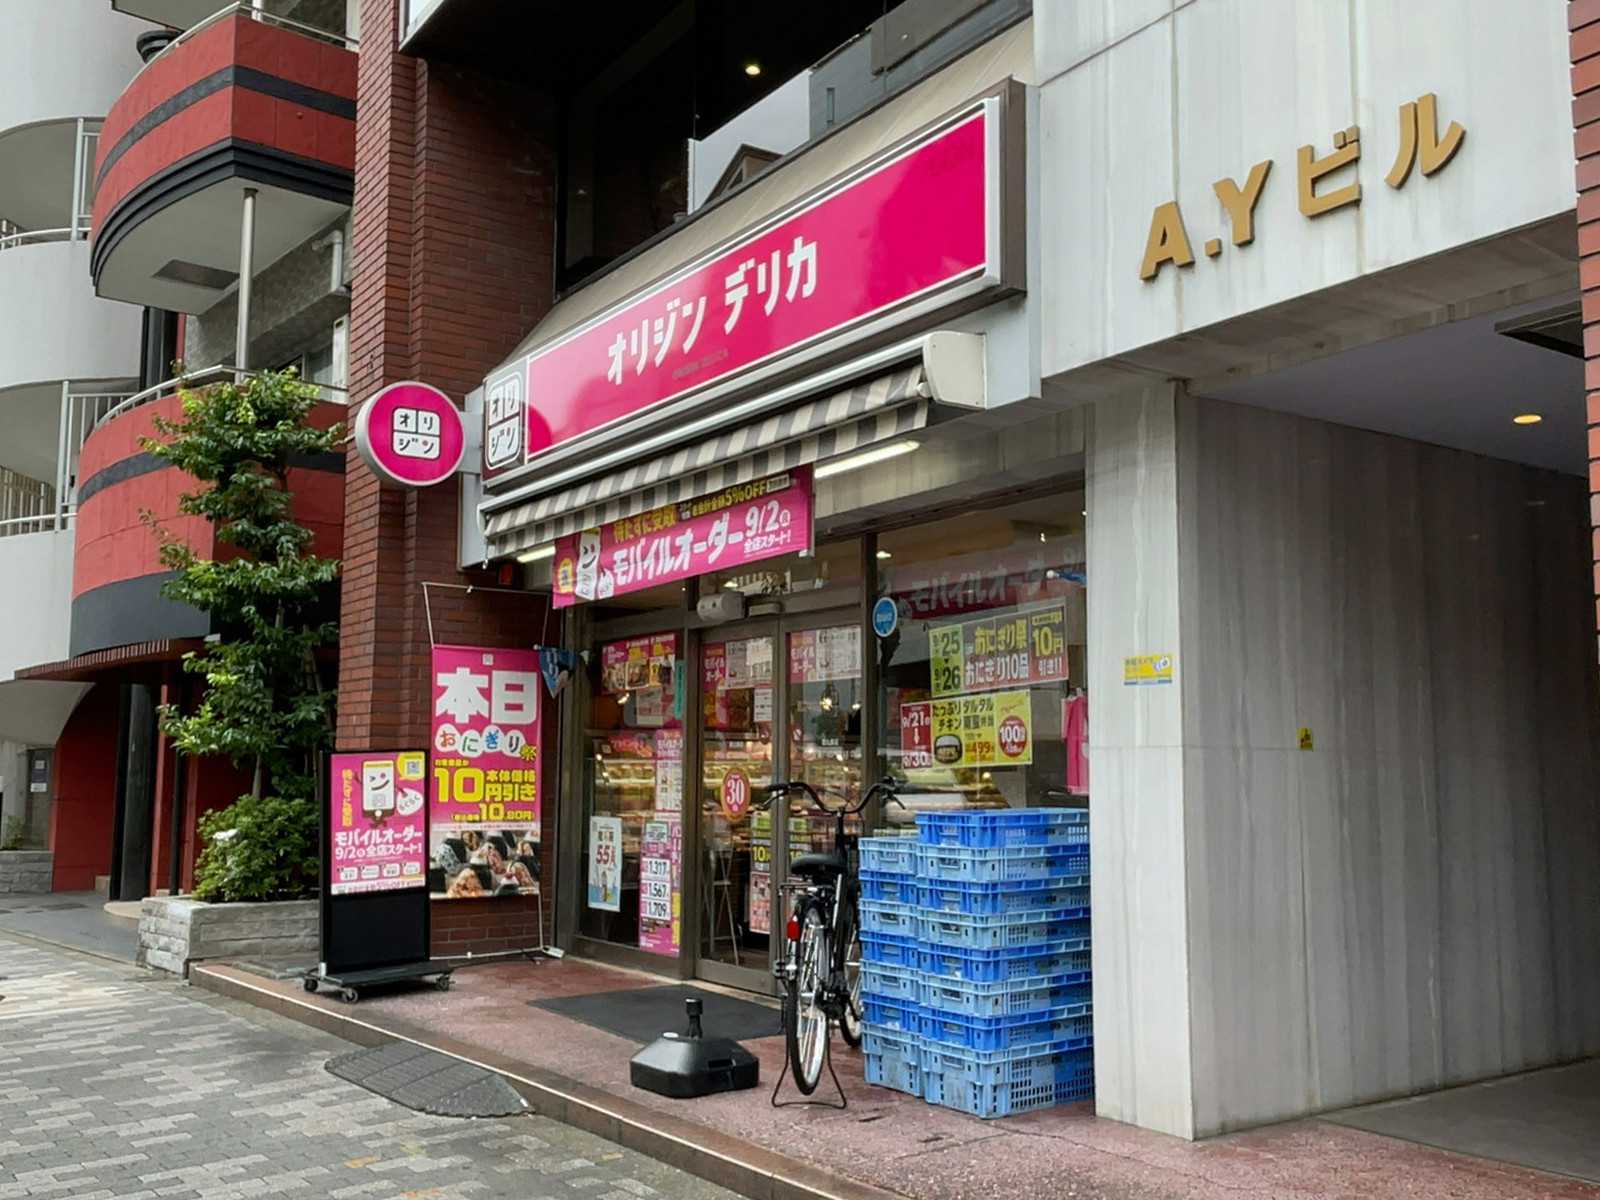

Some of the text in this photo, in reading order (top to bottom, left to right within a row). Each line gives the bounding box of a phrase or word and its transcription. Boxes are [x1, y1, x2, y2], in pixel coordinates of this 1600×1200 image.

[608, 236, 817, 385] オリジン デリカ
[613, 512, 743, 585] モバイルオーダー
[974, 619, 1027, 657] おにぎり祭
[965, 653, 1029, 685] おにぎり10品
[436, 667, 537, 724] 本日
[486, 769, 536, 782] 本体価格
[335, 825, 422, 847] モバイルオーダー
